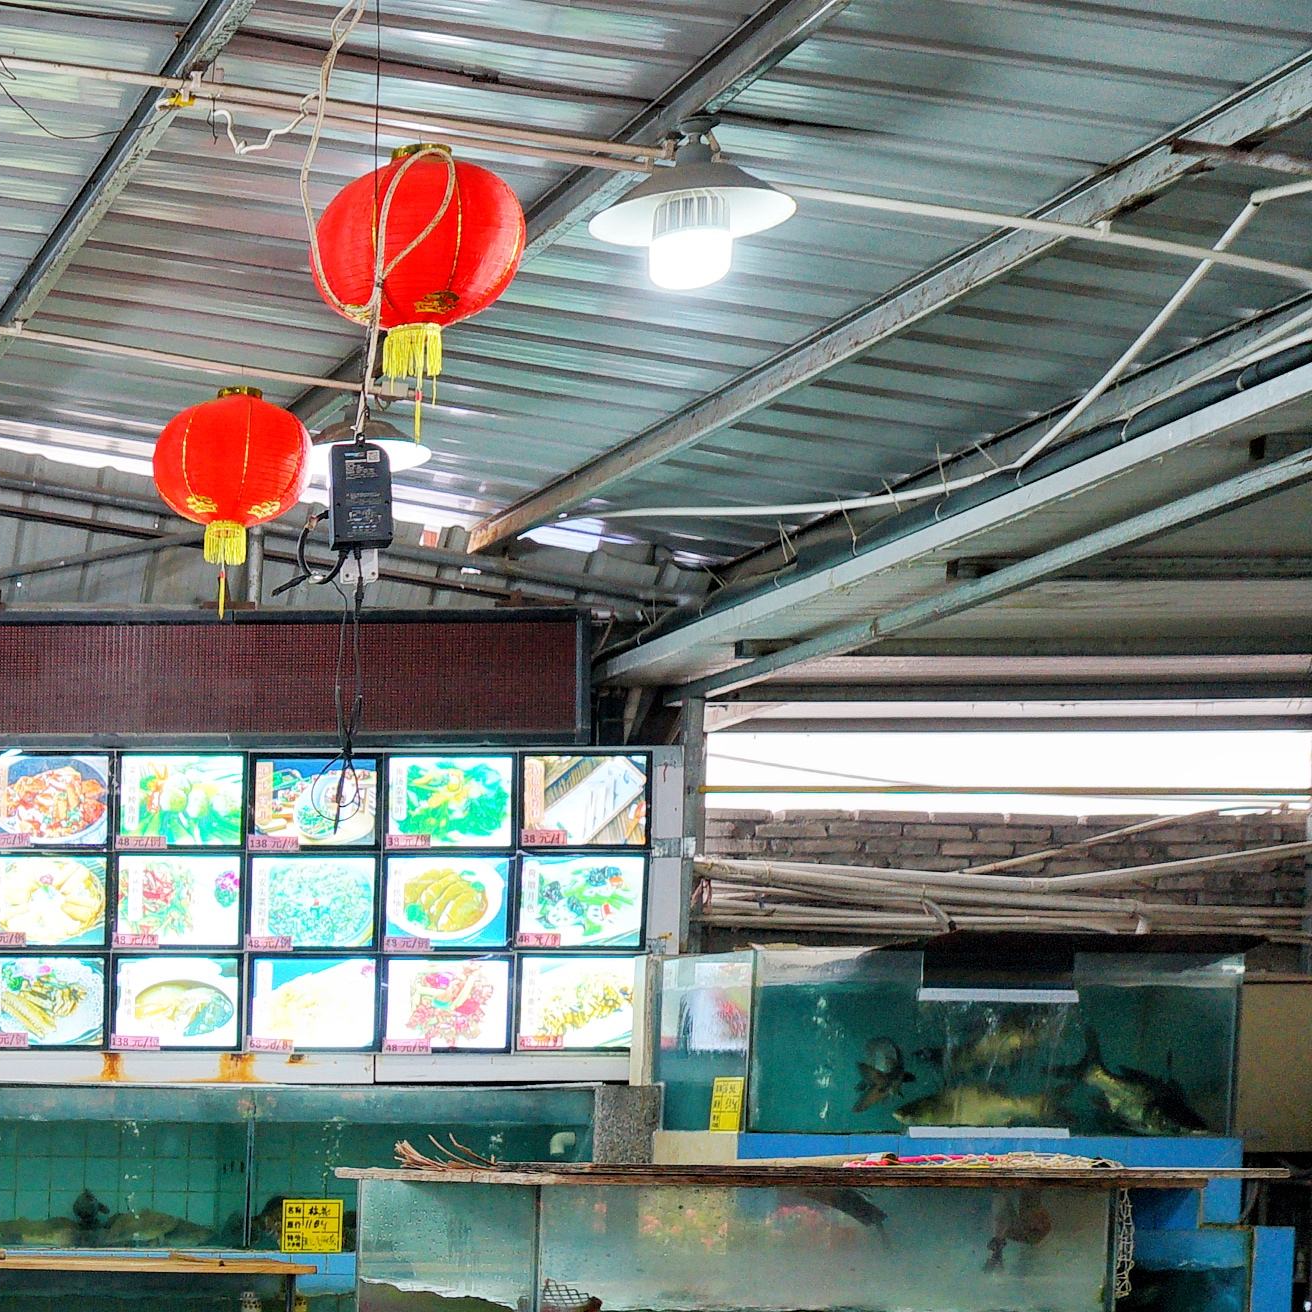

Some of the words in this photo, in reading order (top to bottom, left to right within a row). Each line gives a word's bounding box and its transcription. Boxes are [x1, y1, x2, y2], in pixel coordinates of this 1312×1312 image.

[523, 834, 536, 843] 38
[118, 839, 130, 847] 48
[250, 840, 268, 848] 138
[114, 936, 126, 945] 48
[518, 936, 531, 944] 48
[112, 1037, 129, 1046] 138
[386, 1044, 398, 1052] 48
[288, 1206, 302, 1214] 名称
[287, 1221, 301, 1229] 原价
[287, 1234, 301, 1242] 特价
